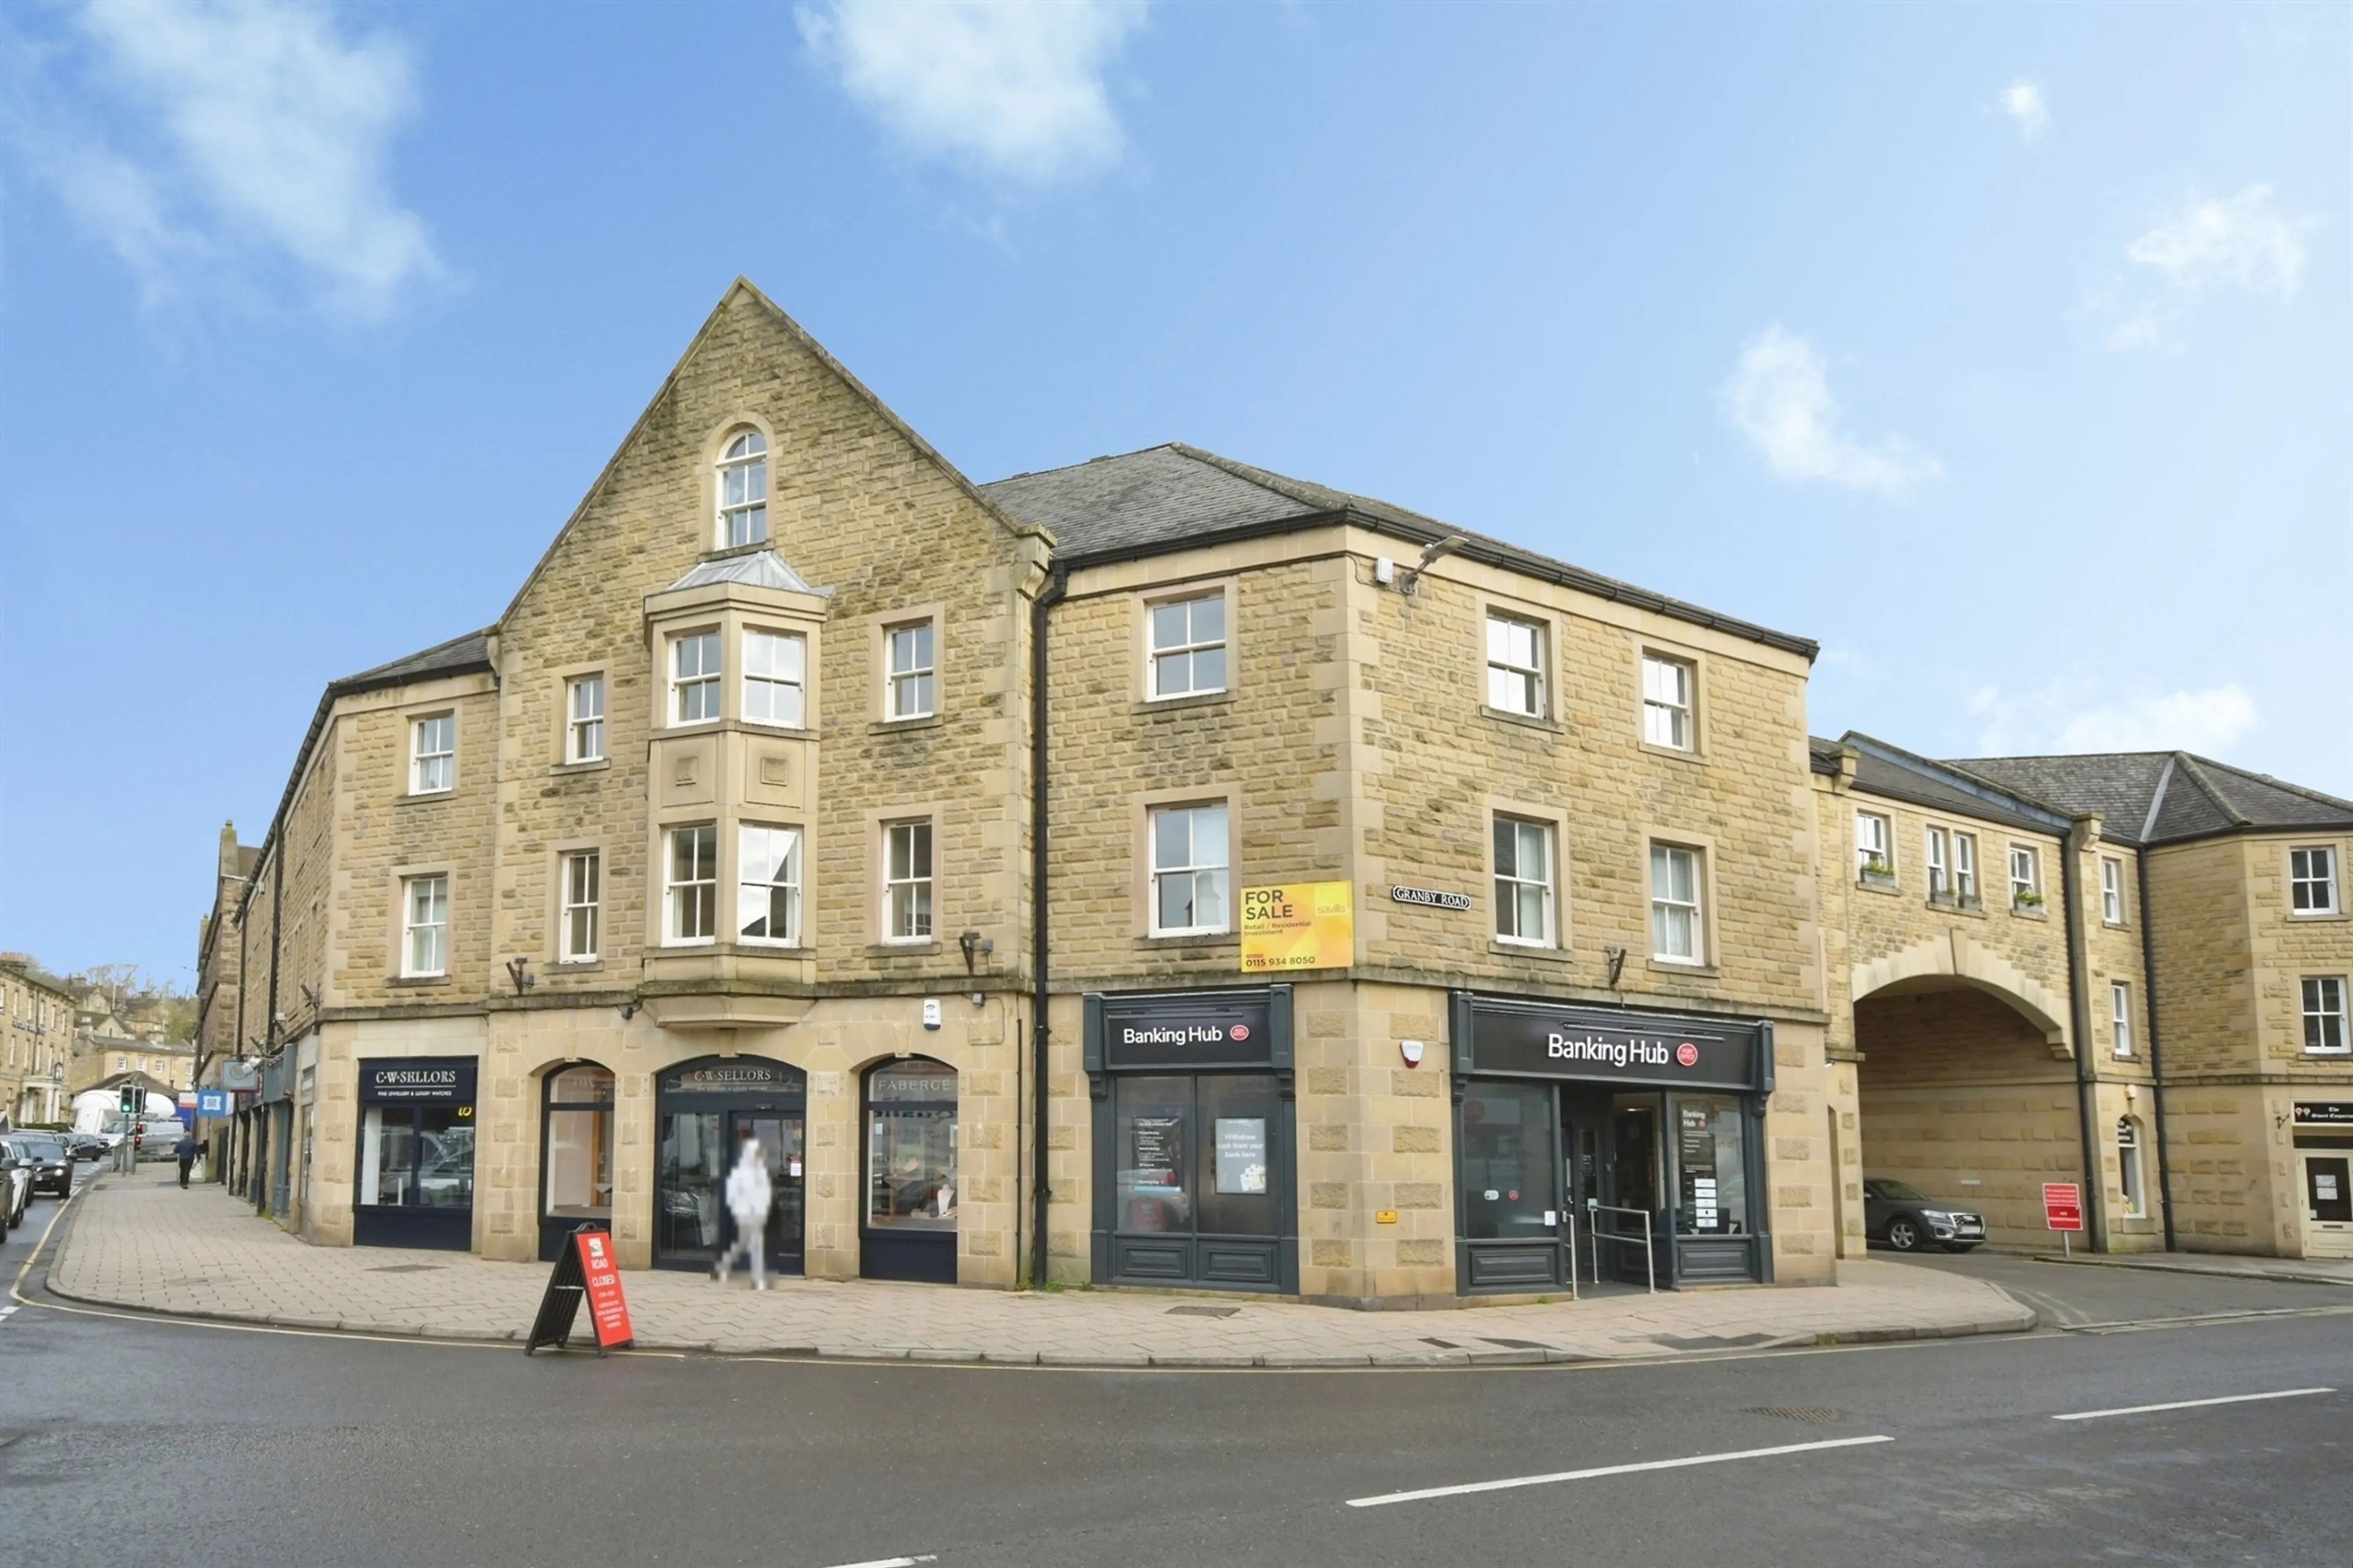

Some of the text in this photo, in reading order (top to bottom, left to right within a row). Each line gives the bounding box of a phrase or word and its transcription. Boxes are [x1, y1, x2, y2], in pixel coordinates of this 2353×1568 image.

[1245, 890, 1283, 905] FOR
[1397, 888, 1468, 907] GRANBY ROAD
[1246, 904, 1293, 920] SALE
[1317, 903, 1346, 915] savills
[1246, 958, 1266, 967] 0115
[1289, 956, 1316, 964] 8050
[1123, 1026, 1222, 1045] Banking Hub
[1548, 1033, 1669, 1067] Banking Hub
[1683, 1110, 1705, 1119] Banking
[591, 1258, 608, 1270] ROAD
[592, 1274, 616, 1287] CLOSED
